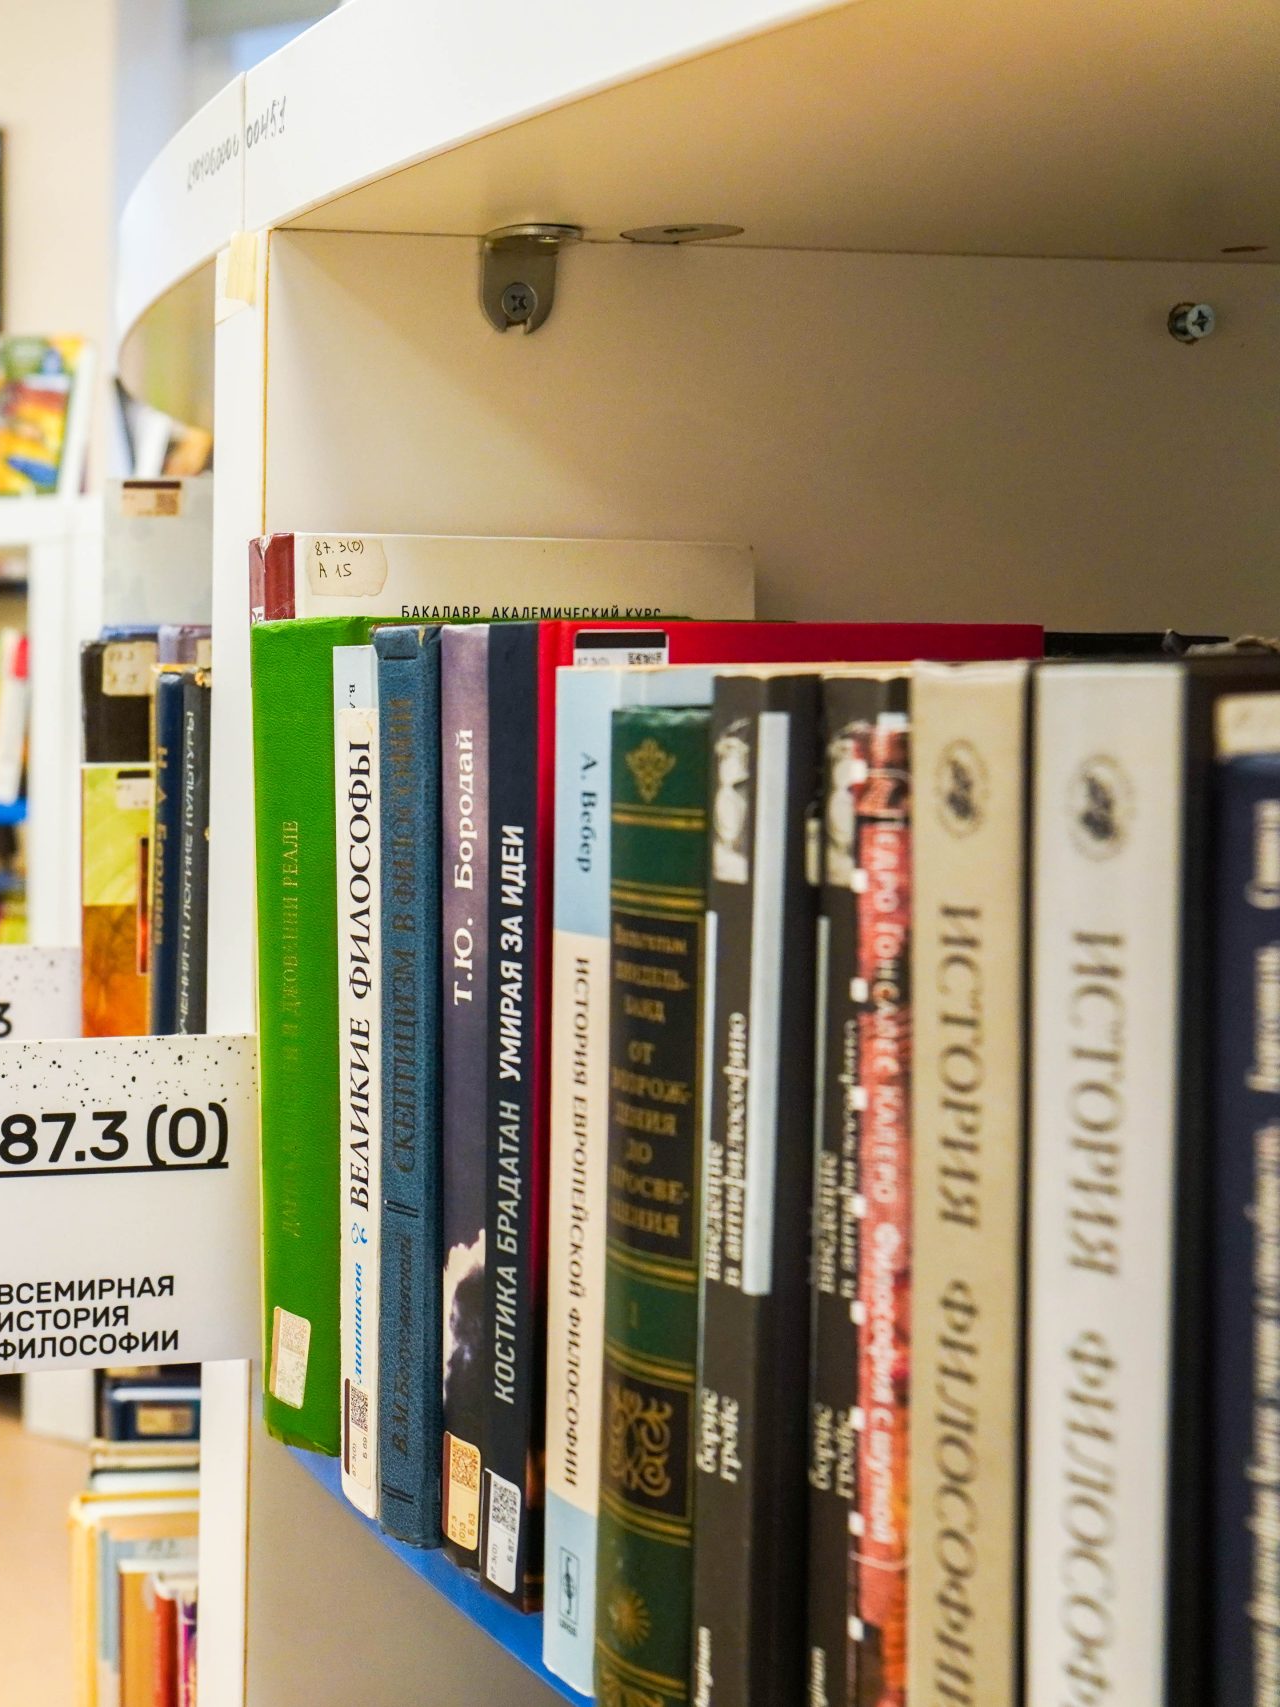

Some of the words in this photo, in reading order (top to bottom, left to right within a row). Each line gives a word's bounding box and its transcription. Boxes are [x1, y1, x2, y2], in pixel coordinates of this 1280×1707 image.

[401, 605, 481, 618] БАКАЛАВР
[492, 604, 619, 619] АКАДЕМИЧЕСКИЙ
[282, 820, 299, 889] РЕАЛЕ
[348, 741, 373, 999] ФИЛОСОФЫ
[453, 728, 477, 890] Бородай
[500, 825, 526, 906] ИДЕИ
[577, 789, 598, 873] Вебер
[453, 917, 474, 1005] Т.Ю.
[501, 915, 523, 952] ЗА
[500, 960, 522, 1081] УМИРАЯ
[572, 957, 591, 1086] ИСТОРИЯ
[938, 904, 983, 1229] ИСТОРИЯ
[0, 1110, 129, 1166] 87.3
[349, 1017, 371, 1212] ВЕЛИКИЕ
[1068, 931, 1125, 1277] ИСТОРИЯ
[496, 1101, 522, 1255] БРАДАТАН
[568, 1095, 589, 1298] ЕВРОПЕЙСКОЙ
[494, 1266, 517, 1404] КОСТИКА
[564, 1307, 584, 1488] ФИЛОСОФИИ
